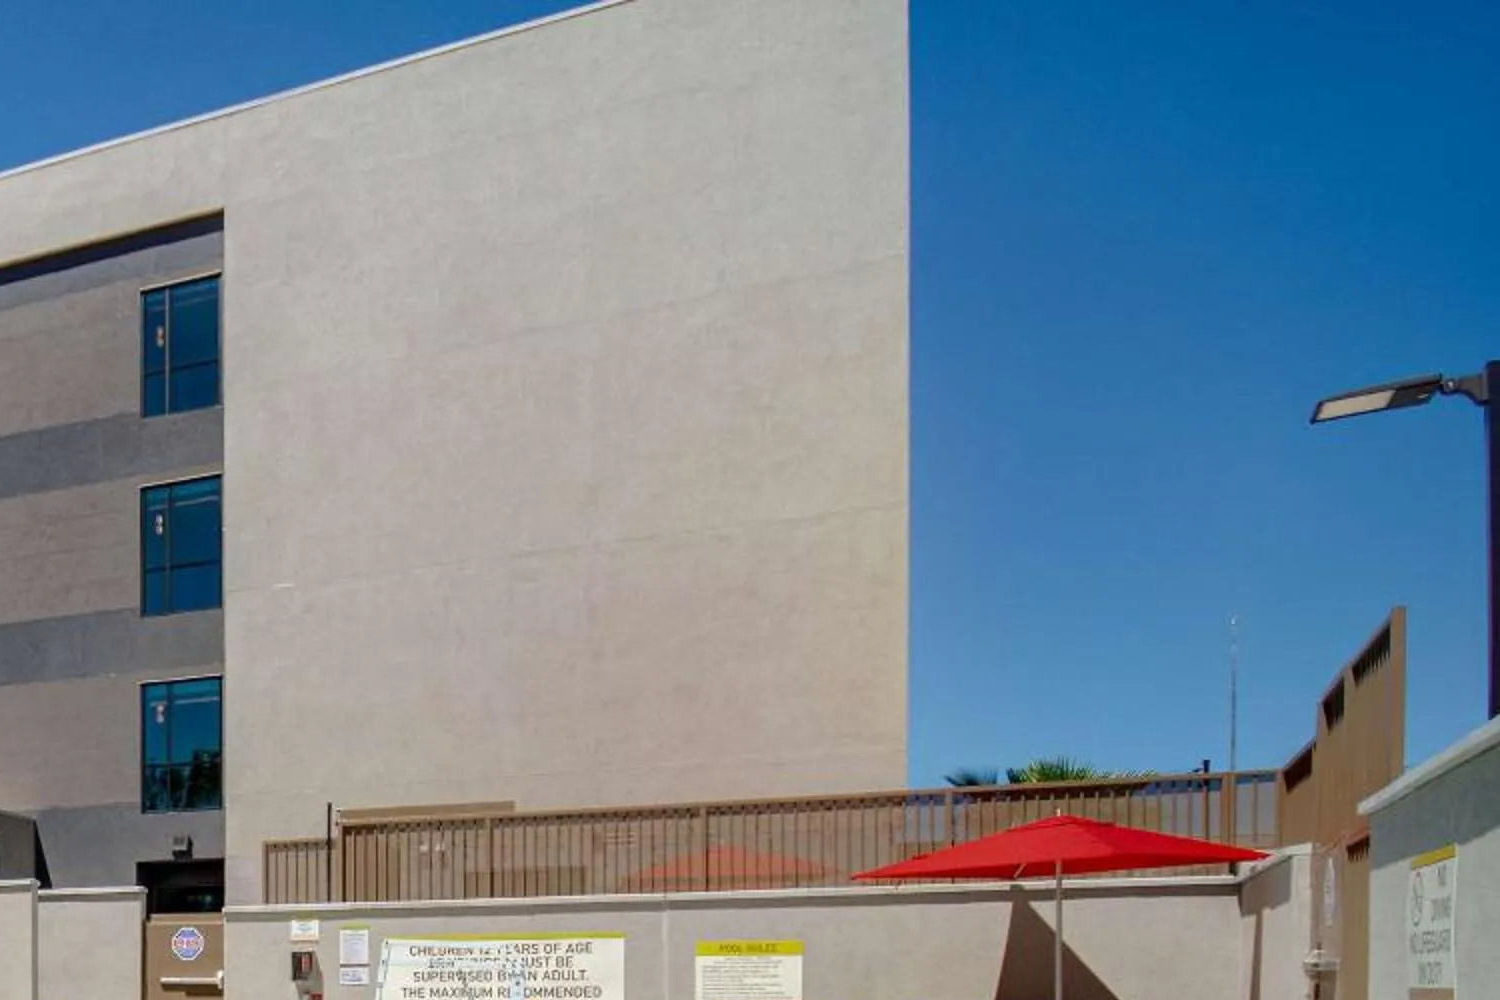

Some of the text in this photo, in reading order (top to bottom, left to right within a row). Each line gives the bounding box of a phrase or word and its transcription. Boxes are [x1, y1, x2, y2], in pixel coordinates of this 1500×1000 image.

[543, 943, 561, 954] OF
[566, 942, 593, 954] AGE
[556, 956, 574, 968] BE
[413, 970, 493, 982] SUPERVISED
[542, 970, 589, 981] ADULT.
[402, 986, 602, 999] THE MAXIMUM REOMMENDED
